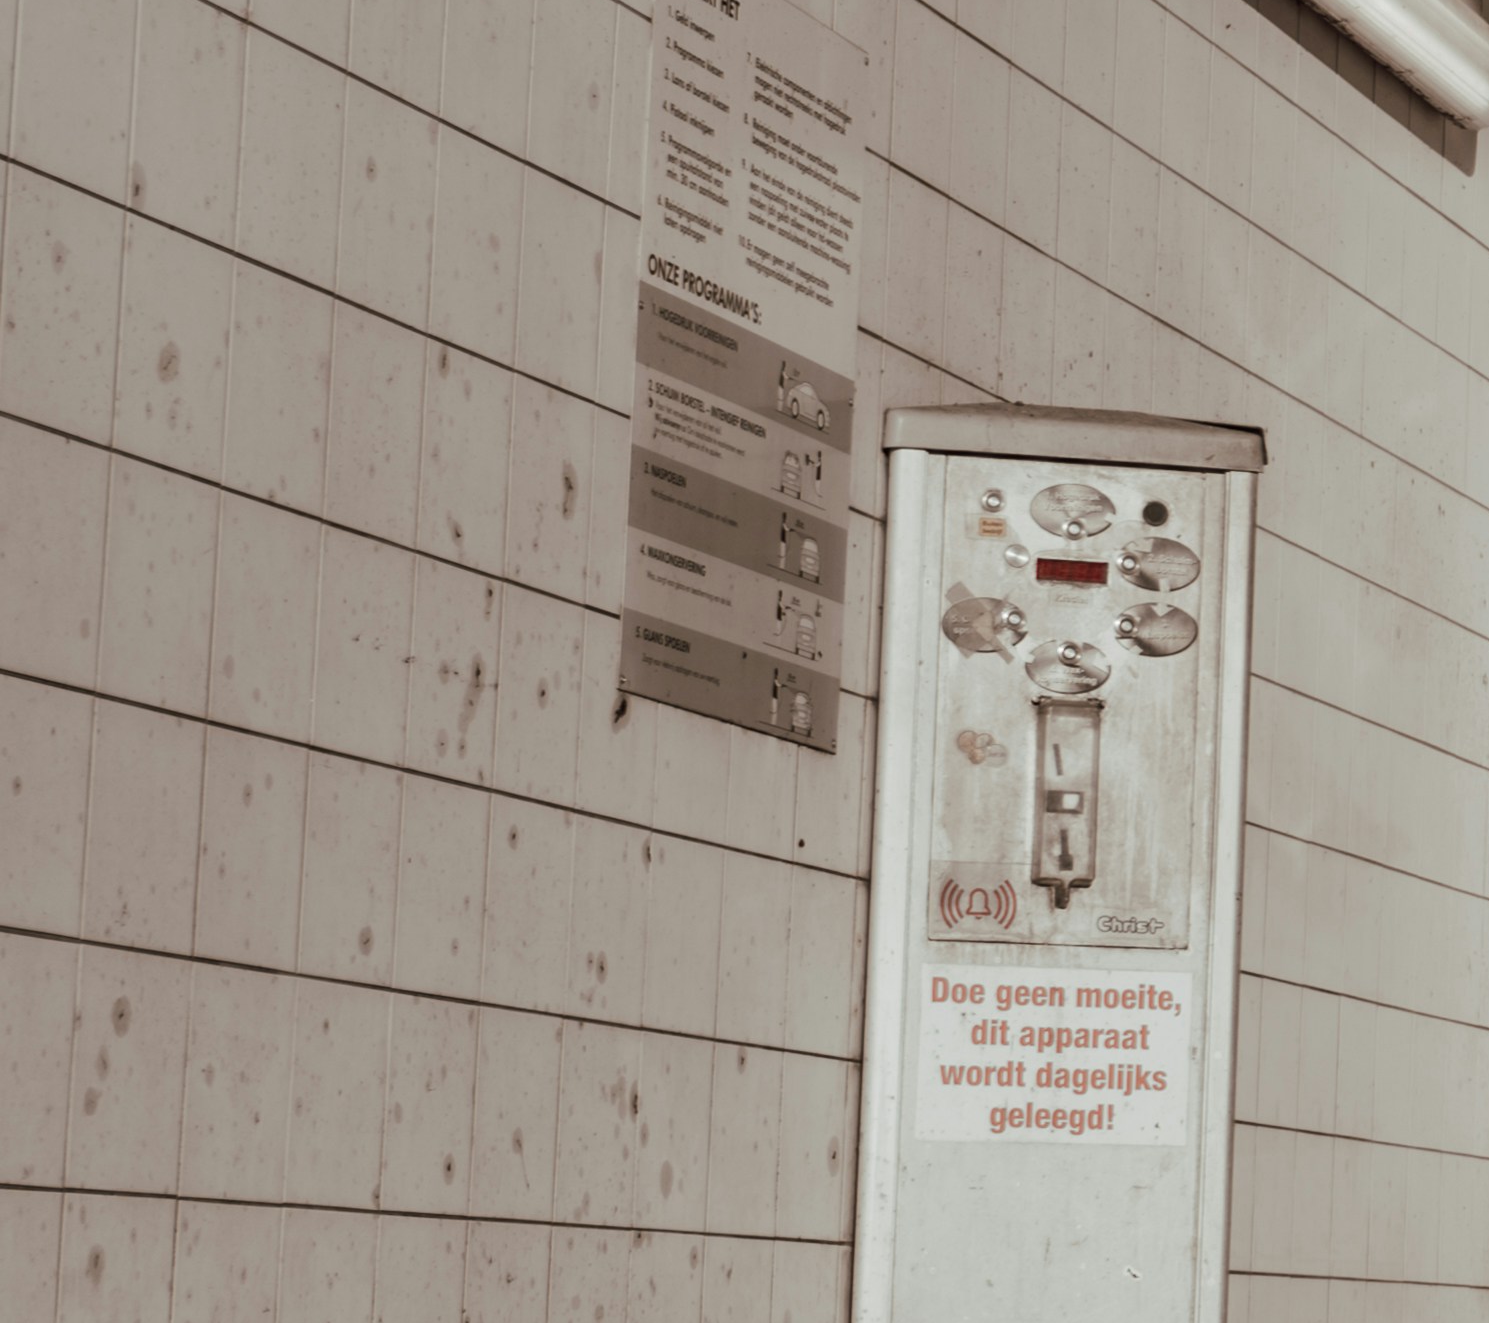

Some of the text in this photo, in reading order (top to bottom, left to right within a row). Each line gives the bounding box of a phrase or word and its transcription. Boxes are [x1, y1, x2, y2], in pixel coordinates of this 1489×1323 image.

[648, 254, 762, 325] ONZE PROGRAMMA'S:
[1097, 915, 1165, 935] Christ
[930, 976, 1182, 1016] Doe geen moeite,
[971, 1019, 1150, 1054] dit apparaat
[939, 1060, 1168, 1096] wordt dagelijks
[989, 1102, 1114, 1135] geleegd!
